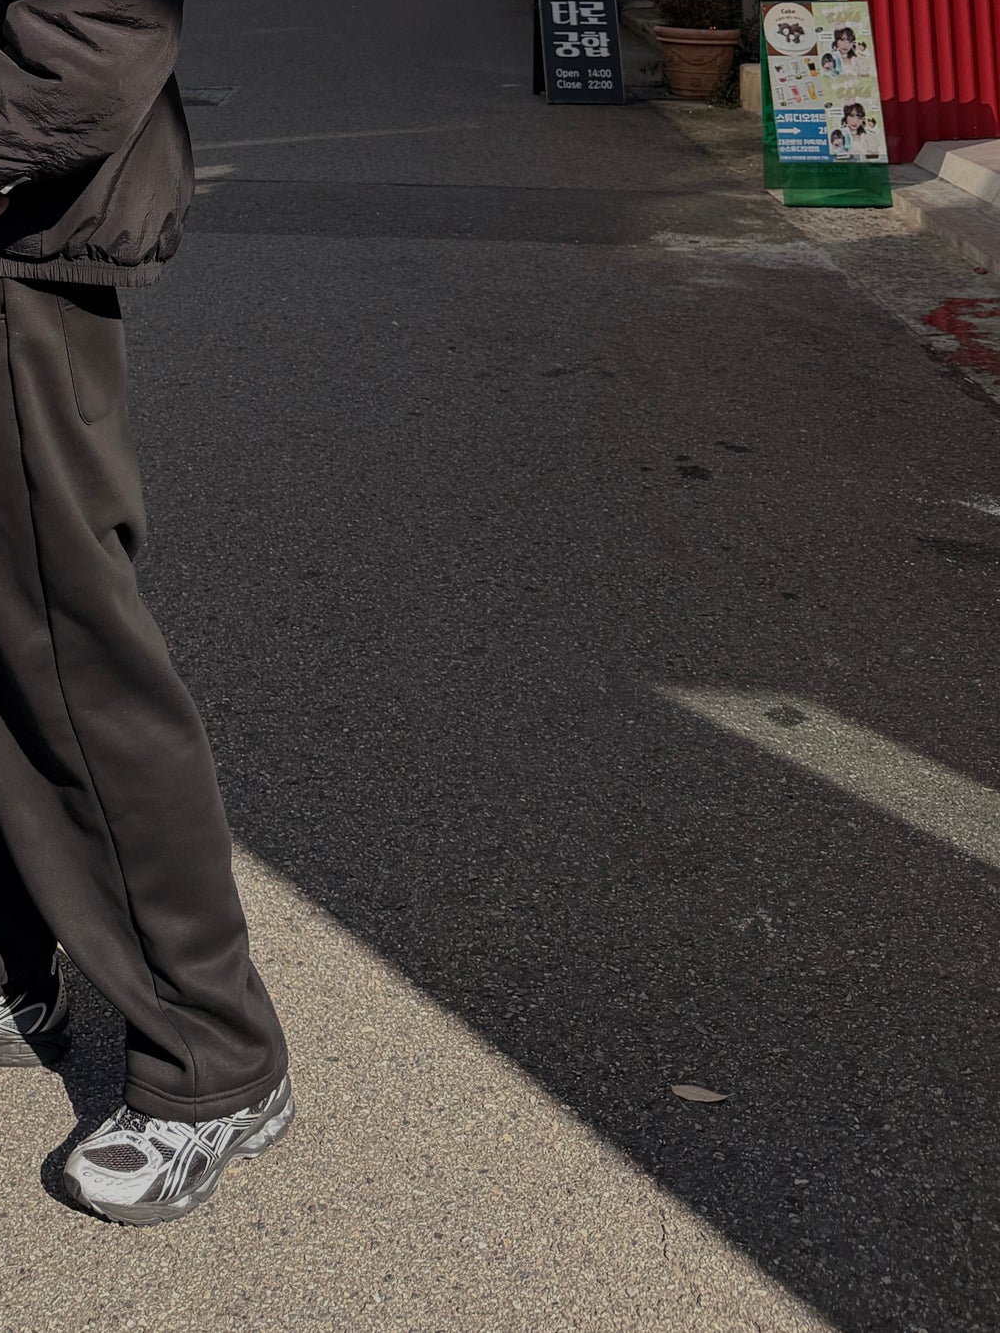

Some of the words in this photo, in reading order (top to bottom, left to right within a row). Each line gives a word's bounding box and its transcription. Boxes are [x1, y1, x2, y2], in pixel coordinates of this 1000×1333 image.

[550, 0, 608, 26] 타로
[553, 31, 611, 58] 궁합
[555, 68, 579, 79] Open
[587, 68, 612, 78] 14:00
[556, 79, 582, 89] Close
[587, 80, 613, 89] 22:00
